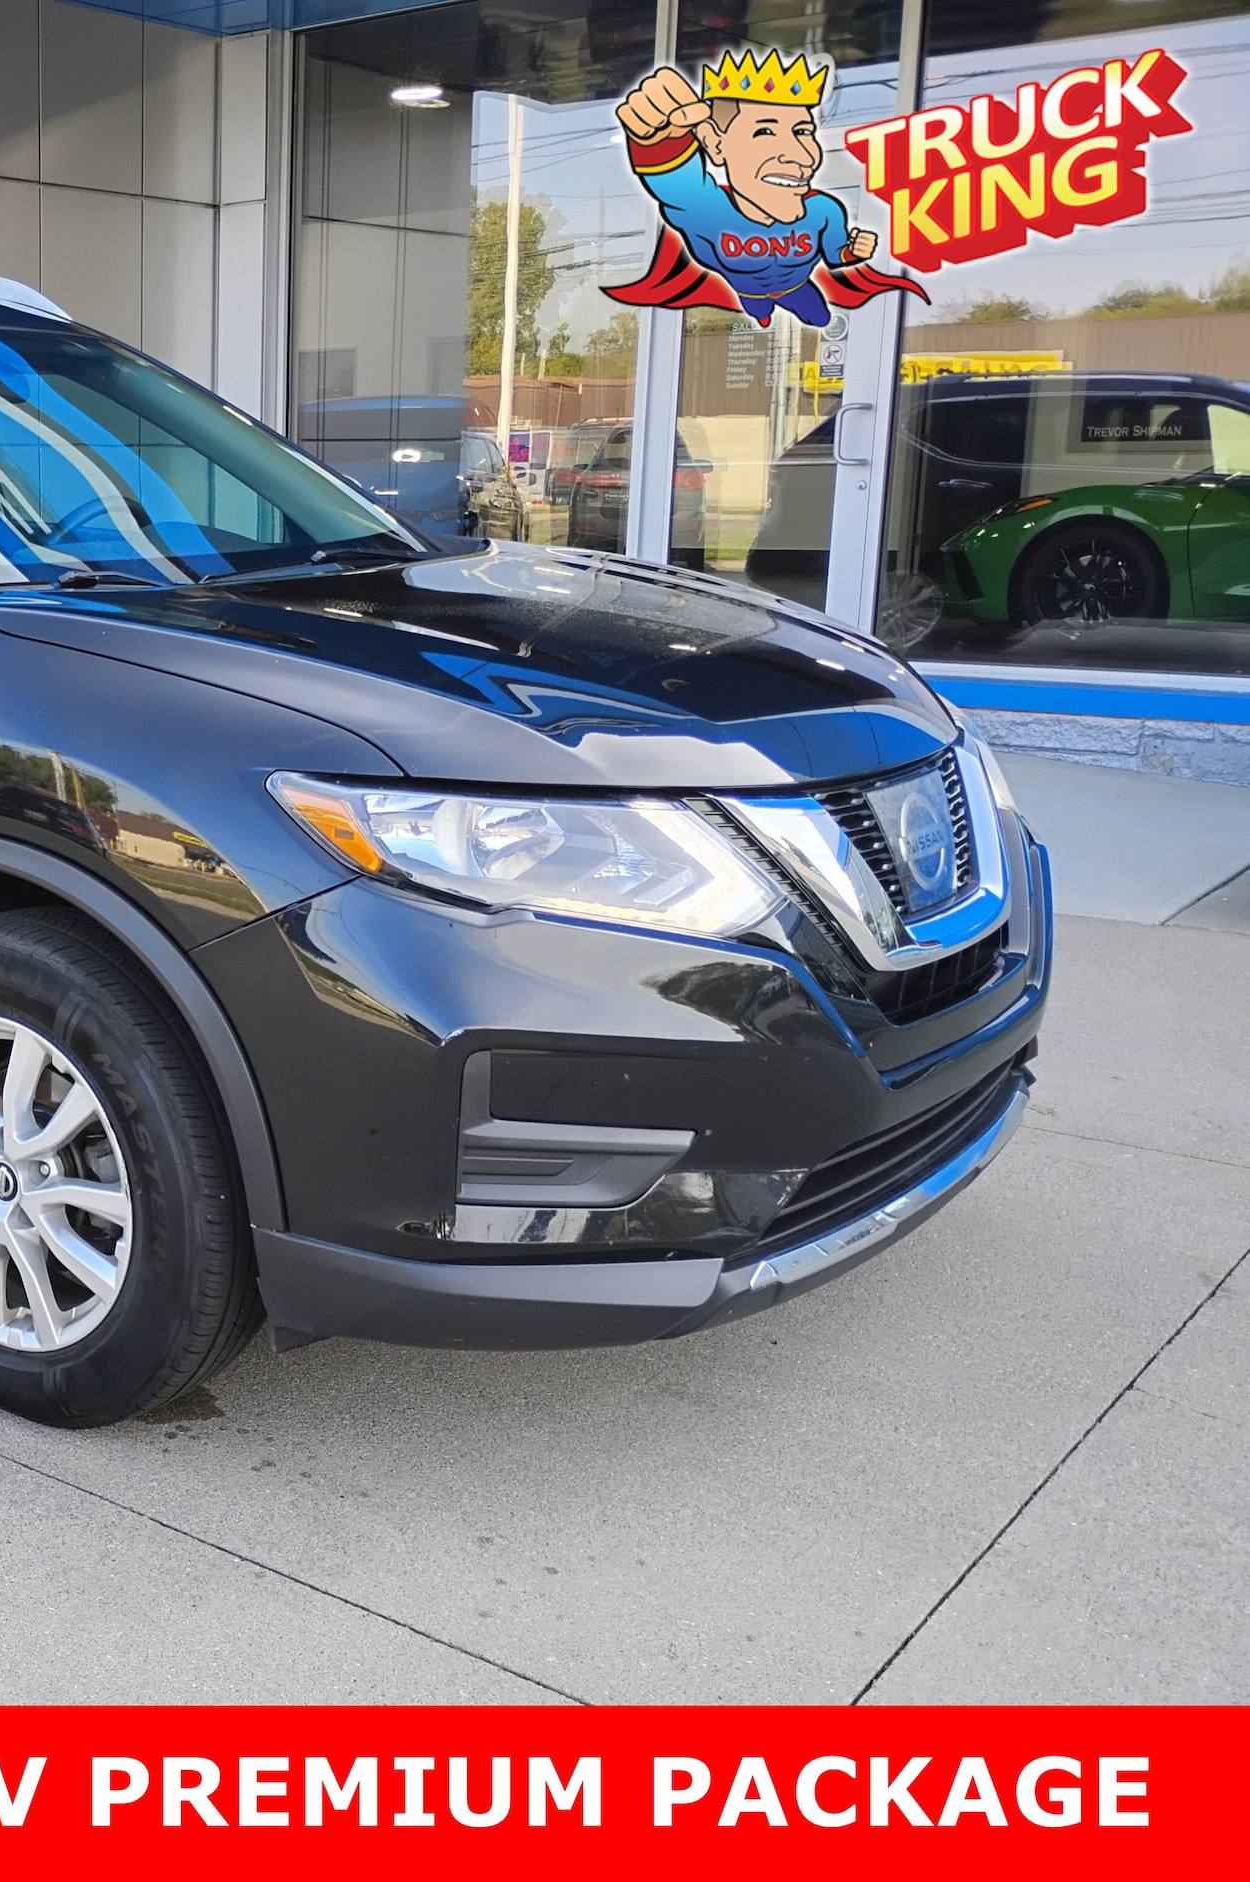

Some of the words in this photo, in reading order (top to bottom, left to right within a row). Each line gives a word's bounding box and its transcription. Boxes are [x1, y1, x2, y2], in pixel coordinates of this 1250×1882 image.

[728, 334, 755, 342] Monday
[728, 342, 754, 350] Tuesday
[726, 366, 747, 374] Friday
[1087, 426, 1129, 438] TREVOR
[1133, 424, 1182, 437] SHIPMAN
[906, 828, 945, 855] NISSAN
